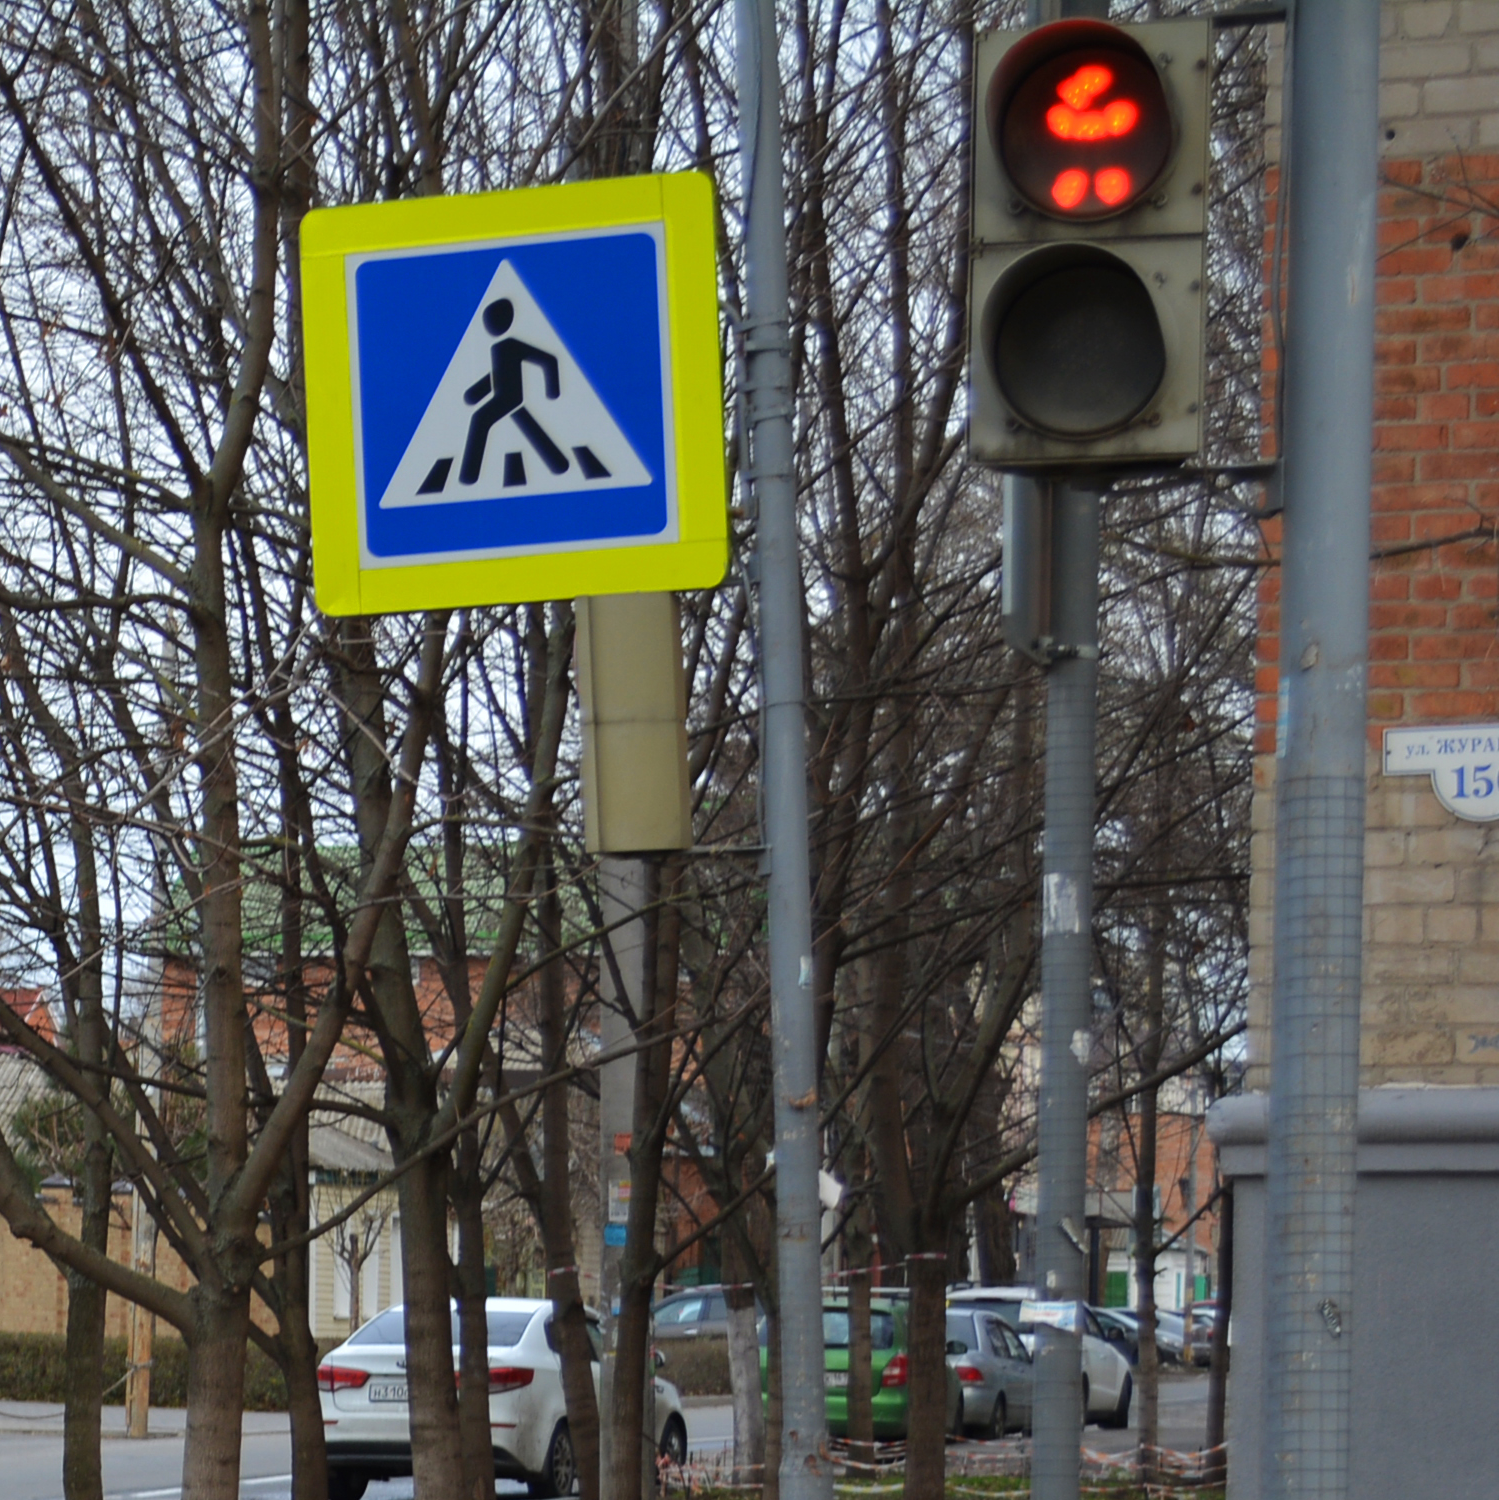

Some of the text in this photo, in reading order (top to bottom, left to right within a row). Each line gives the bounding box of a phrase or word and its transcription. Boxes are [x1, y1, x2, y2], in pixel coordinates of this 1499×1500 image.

[1405, 737, 1499, 759] ул. ЖУРА
[1450, 763, 1499, 799] 15
